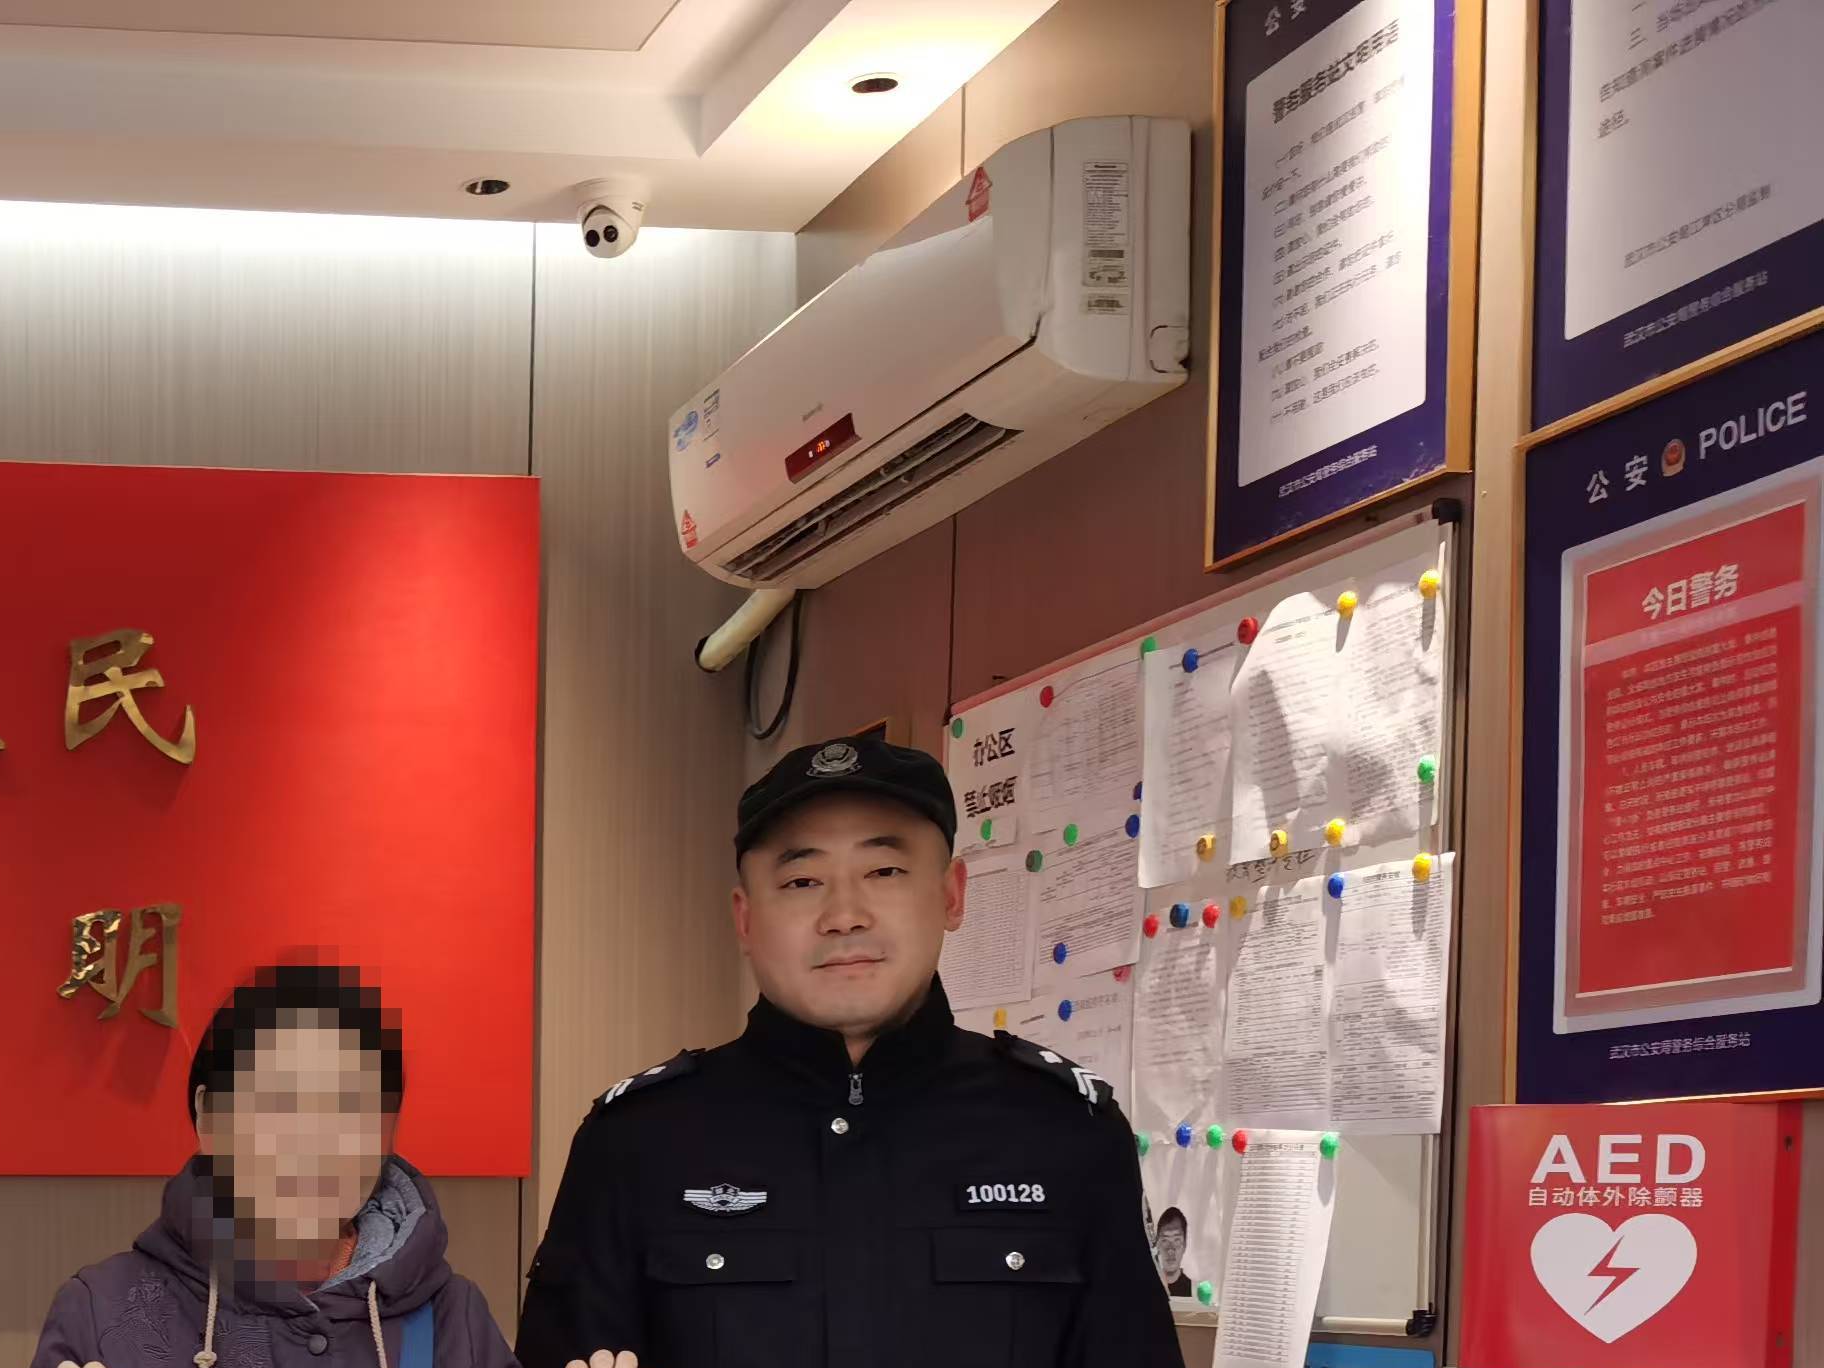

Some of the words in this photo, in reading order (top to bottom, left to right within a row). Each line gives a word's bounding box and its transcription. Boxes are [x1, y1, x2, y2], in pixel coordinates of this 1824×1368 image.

[1585, 454, 1649, 504] 公安
[1698, 390, 1808, 460] POLICE
[1641, 563, 1740, 620] 今日警务
[973, 727, 1016, 767] 办公区
[1530, 1133, 1706, 1184] AED
[966, 1183, 1046, 1205] 100128
[1528, 1186, 1704, 1208] 自动体外除颤器
